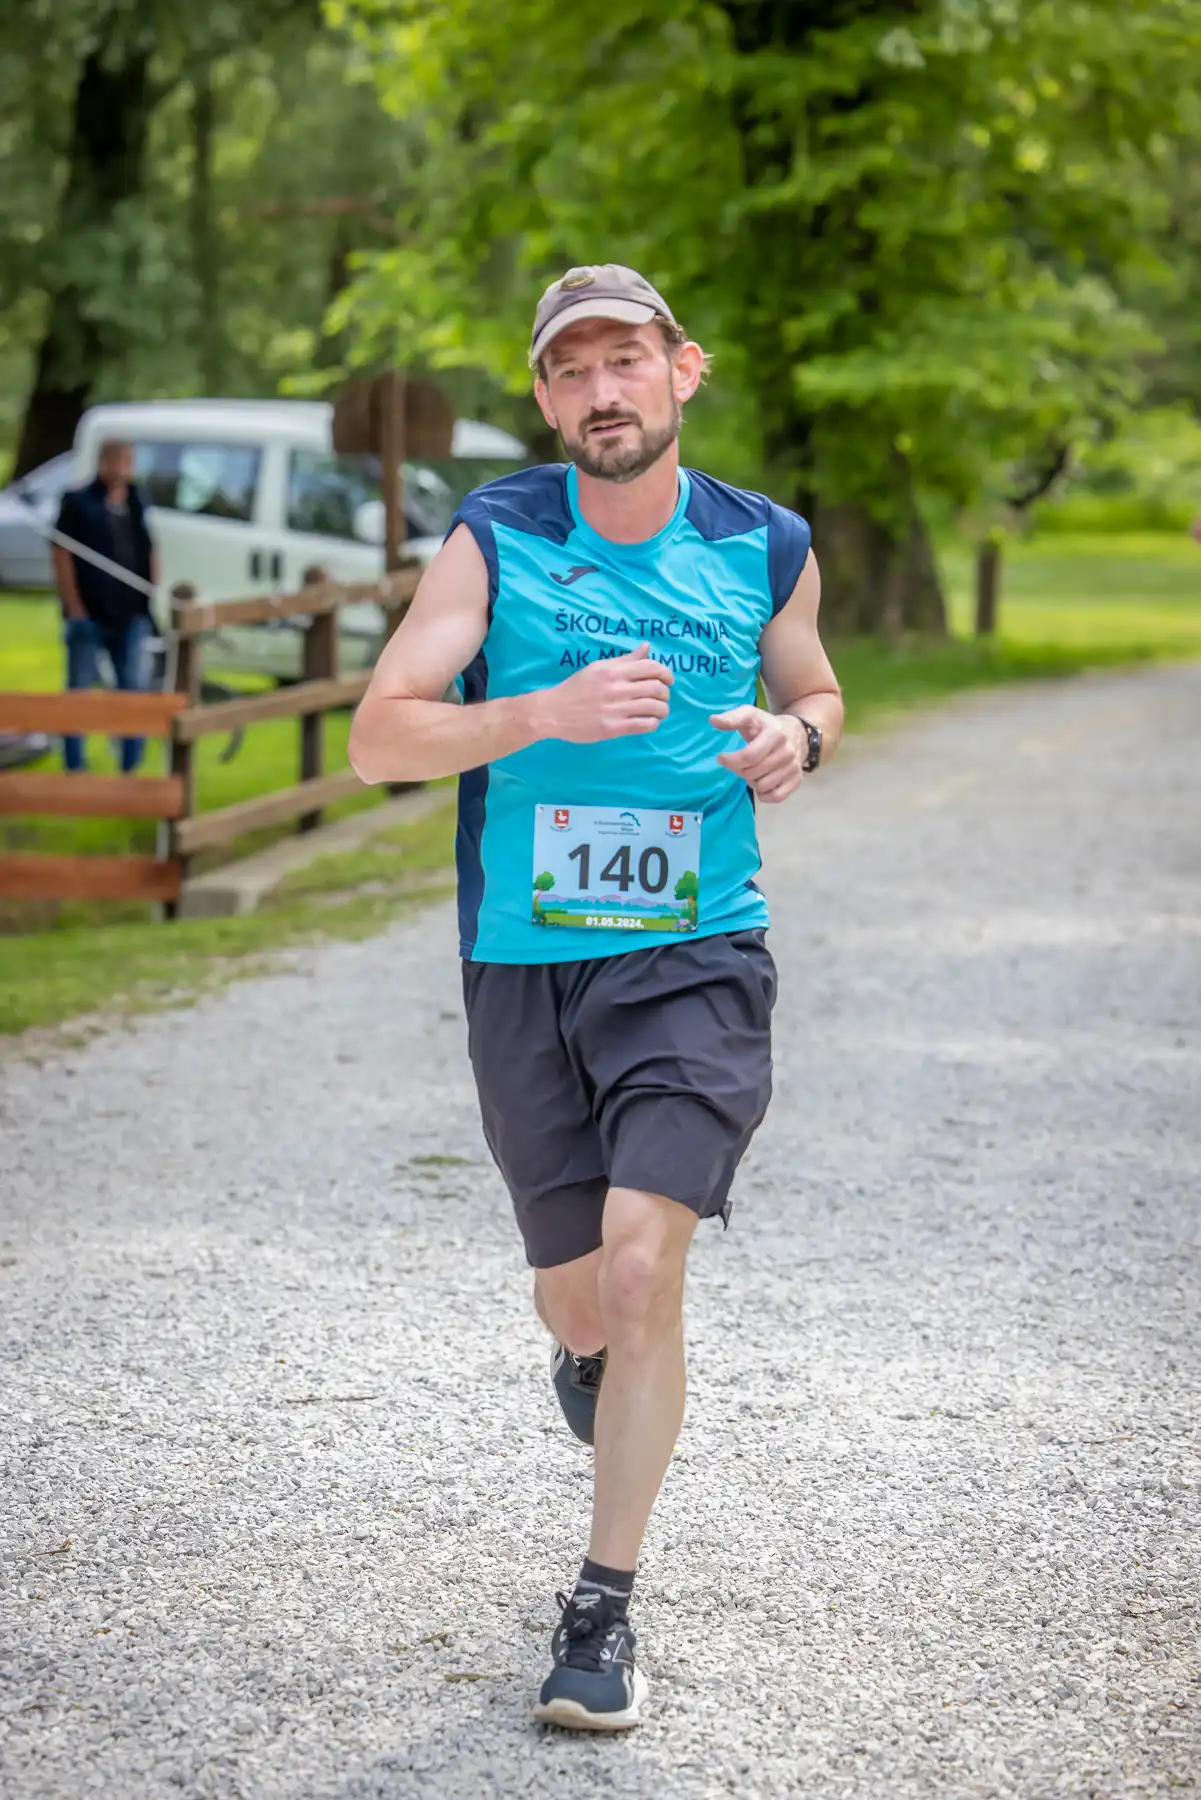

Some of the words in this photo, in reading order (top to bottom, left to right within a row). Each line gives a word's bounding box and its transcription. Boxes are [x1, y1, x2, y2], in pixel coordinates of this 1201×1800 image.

[555, 608, 629, 636] ŠKOLA
[636, 615, 730, 643] TRČANJA
[559, 649, 590, 667] AK
[598, 648, 730, 677] MMURJE
[567, 843, 669, 894] 140
